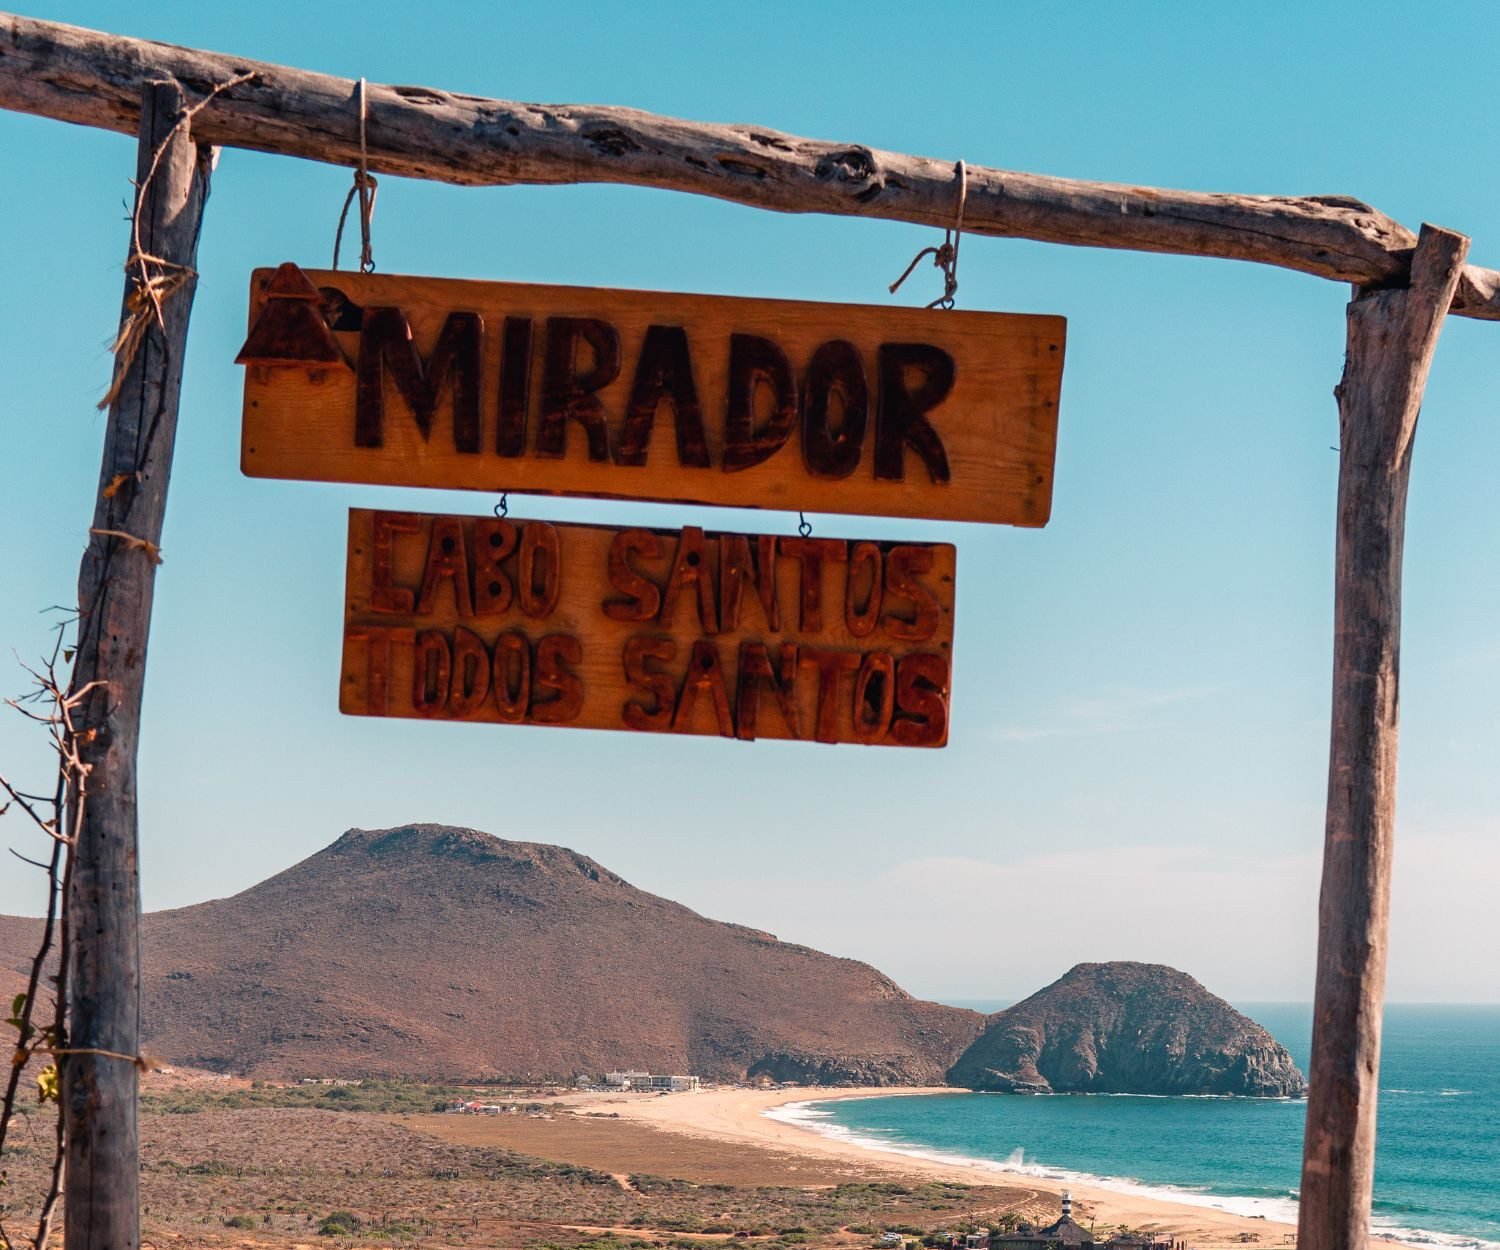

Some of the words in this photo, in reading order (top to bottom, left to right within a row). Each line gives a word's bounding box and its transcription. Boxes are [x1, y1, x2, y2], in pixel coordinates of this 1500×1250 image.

[354, 306, 957, 484] MIRADOR
[370, 510, 560, 618] CABO
[602, 525, 939, 641] SANTOS
[344, 625, 584, 723] TODOS
[622, 636, 949, 744] SANTOS
